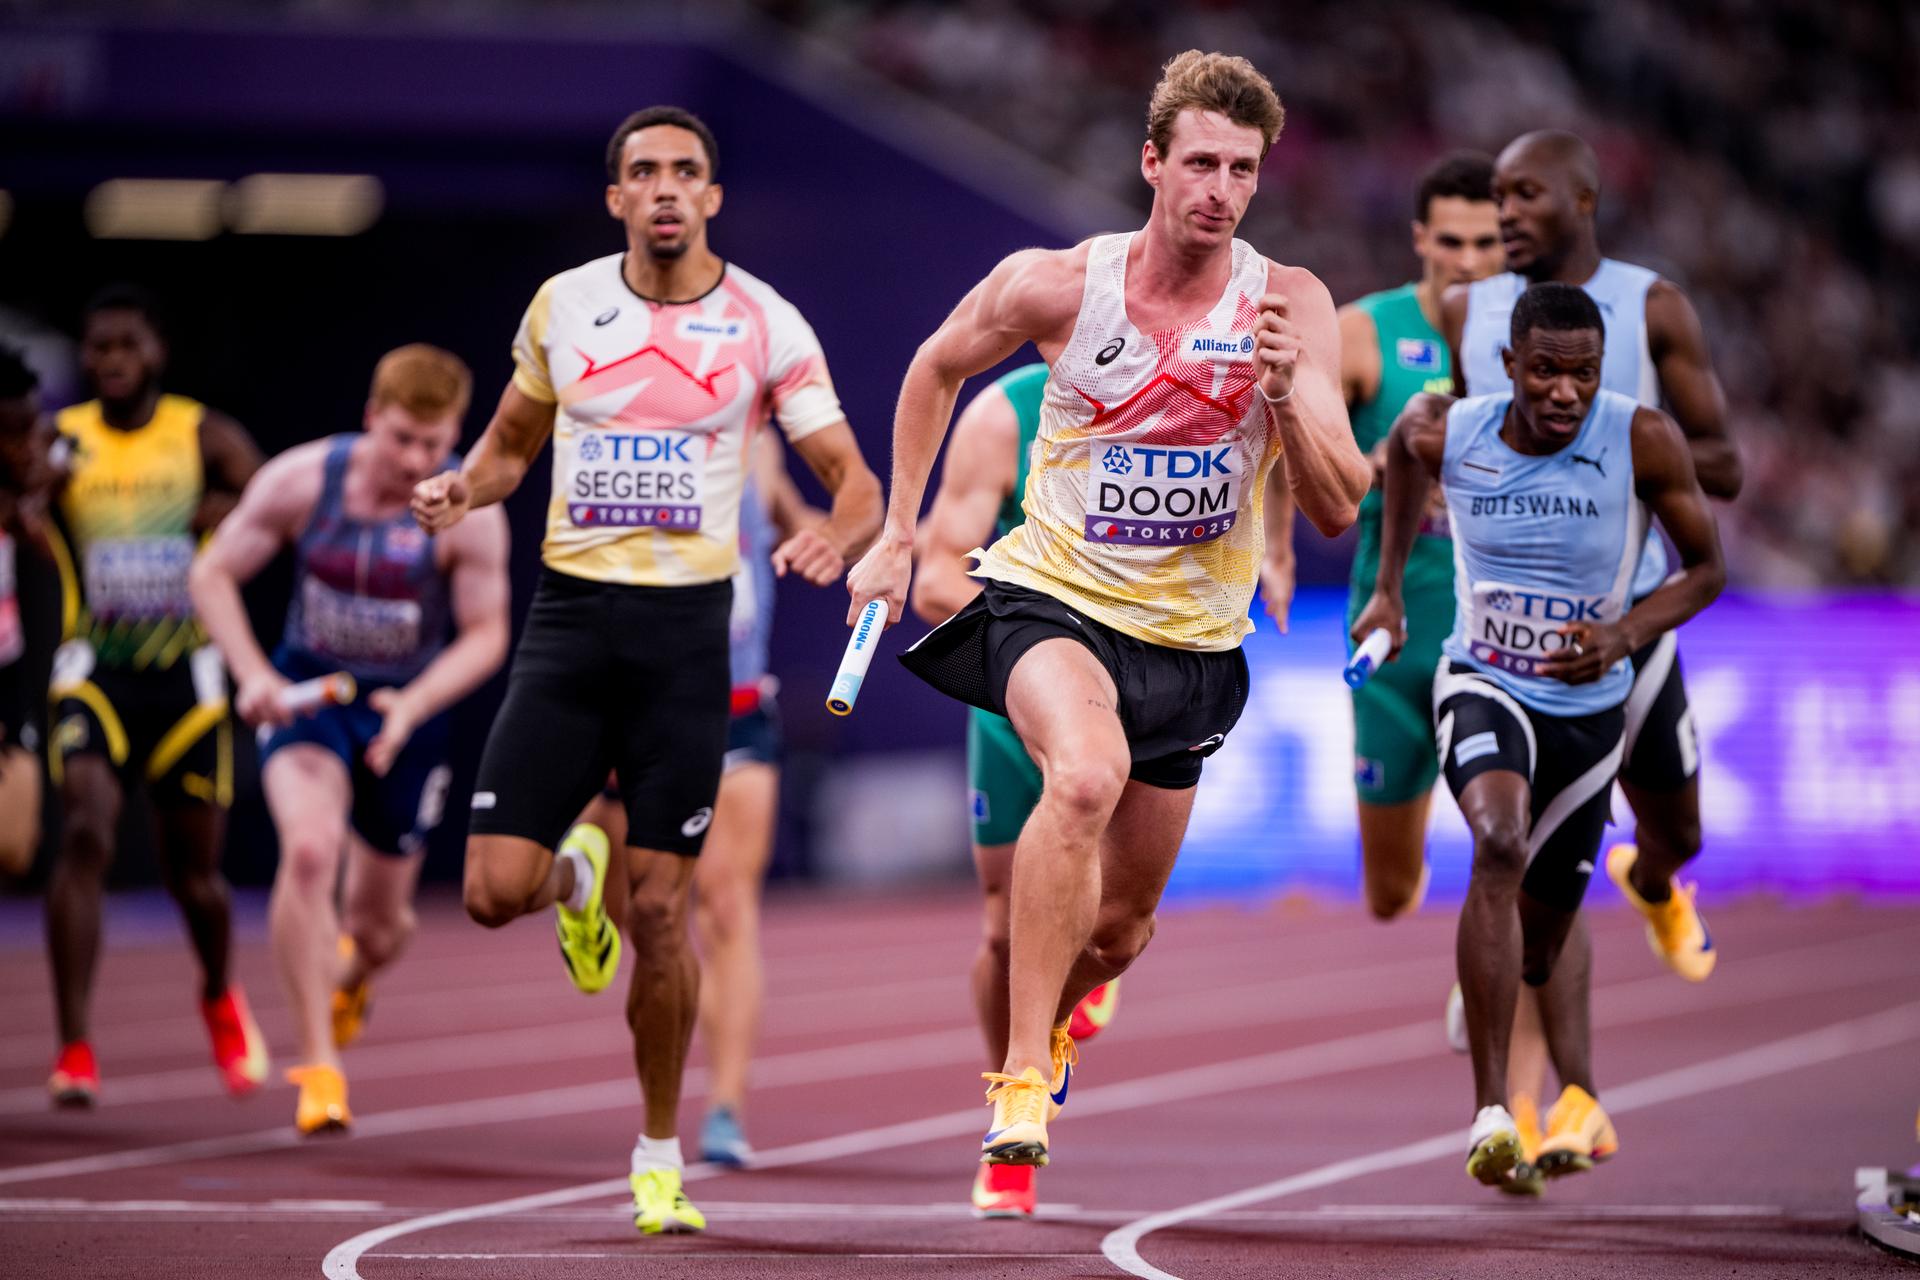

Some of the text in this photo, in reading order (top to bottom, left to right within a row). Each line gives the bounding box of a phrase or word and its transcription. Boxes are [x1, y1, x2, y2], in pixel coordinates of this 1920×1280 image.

[1192, 338, 1238, 353] Allianz
[605, 434, 691, 463] TDK
[1133, 447, 1232, 478] TDK
[575, 471, 696, 500] SEGERS
[1099, 482, 1230, 517] DOOM
[1471, 496, 1600, 518] BOTSWANA
[1514, 591, 1606, 622] TDK
[857, 603, 878, 643] MONDO
[1484, 616, 1579, 652] NDO
